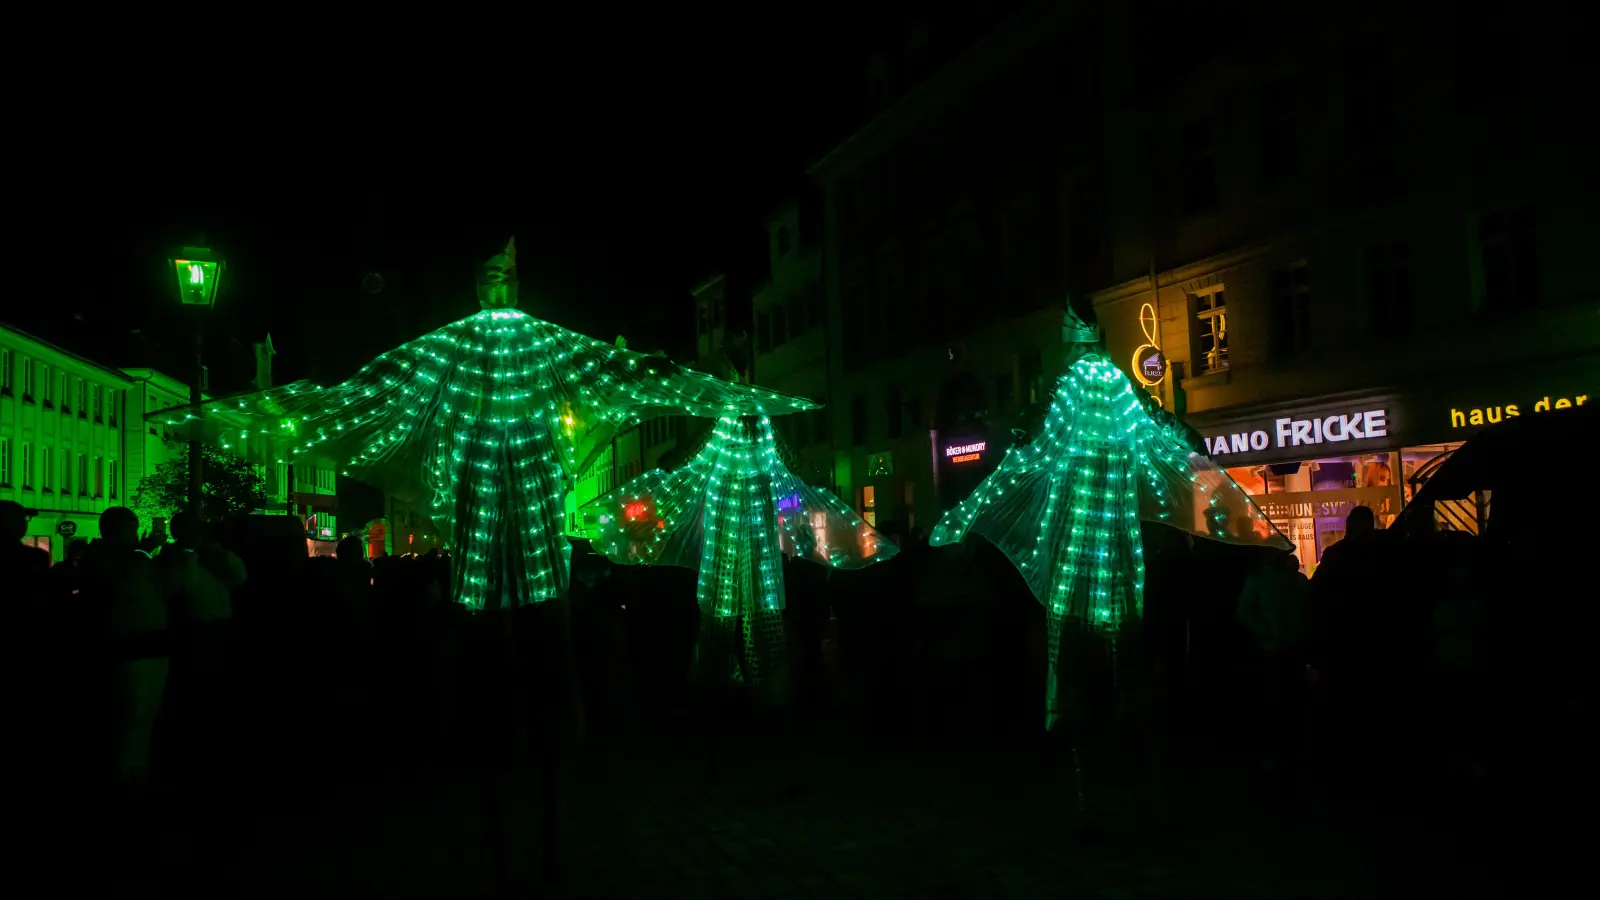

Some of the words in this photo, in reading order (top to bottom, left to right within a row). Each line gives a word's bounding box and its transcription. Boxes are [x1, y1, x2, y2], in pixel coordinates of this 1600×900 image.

[1451, 404, 1520, 428] haus
[1534, 394, 1588, 413] der
[1204, 430, 1269, 456] IANO
[1275, 409, 1387, 448] FRICKE
